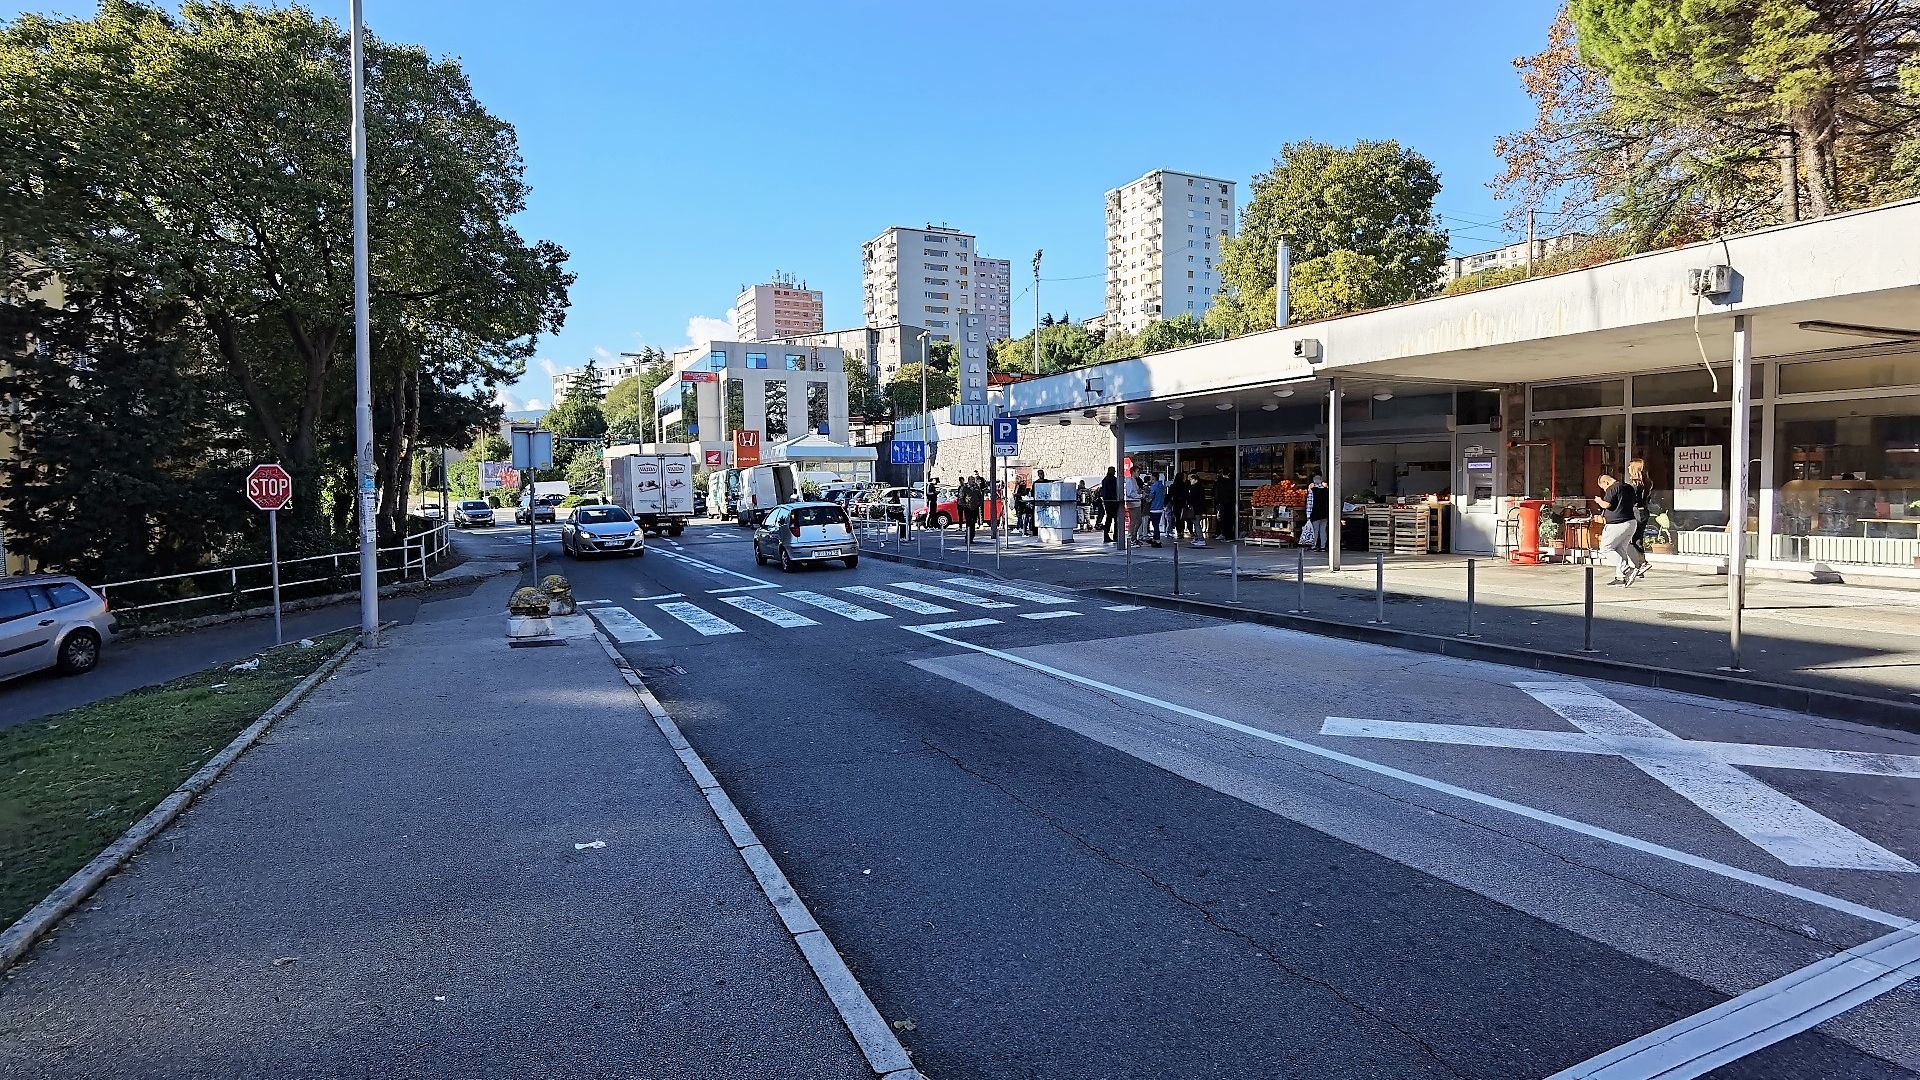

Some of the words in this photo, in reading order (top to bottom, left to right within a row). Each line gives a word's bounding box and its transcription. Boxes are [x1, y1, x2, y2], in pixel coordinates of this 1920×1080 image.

[967, 317, 981, 401] PEKARA
[955, 404, 997, 426] ARENA
[999, 422, 1012, 440] P
[250, 478, 288, 497] STOP
